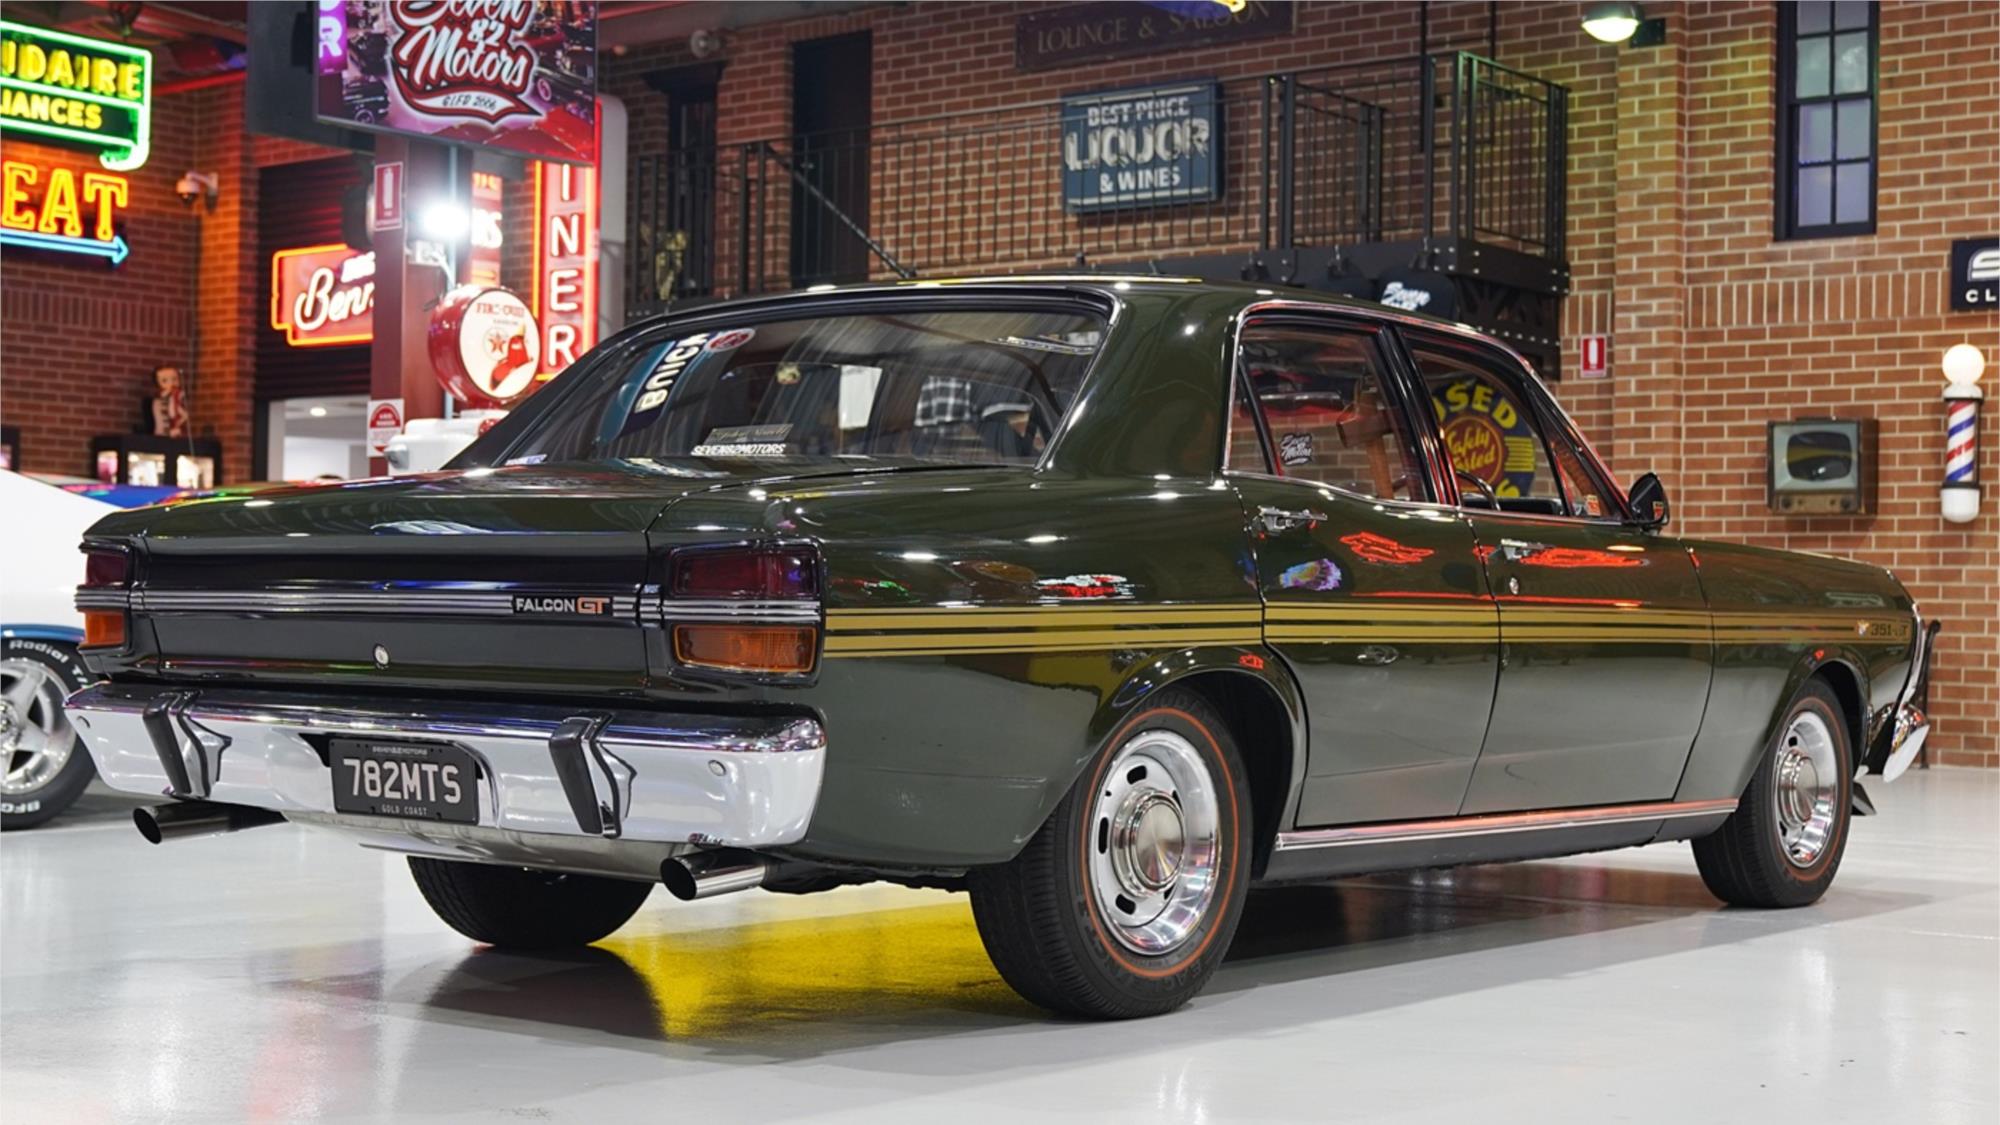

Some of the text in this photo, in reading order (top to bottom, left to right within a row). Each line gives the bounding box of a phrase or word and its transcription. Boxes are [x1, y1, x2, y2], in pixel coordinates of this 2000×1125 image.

[467, 18, 505, 47] 82
[1038, 18, 1128, 53] LOUNGE
[1138, 16, 1155, 40] &
[399, 25, 528, 87] Motors
[0, 88, 102, 129] IANCES
[1087, 96, 1190, 127] BEST PRICE
[1065, 118, 1209, 171] LIQUOR
[1100, 165, 1181, 194] & WINES
[1, 161, 128, 241] EAT
[515, 596, 611, 614] FALCON GT
[9, 640, 70, 664] Radial
[343, 757, 462, 804] 782MTS
[404, 805, 428, 816] COAST
